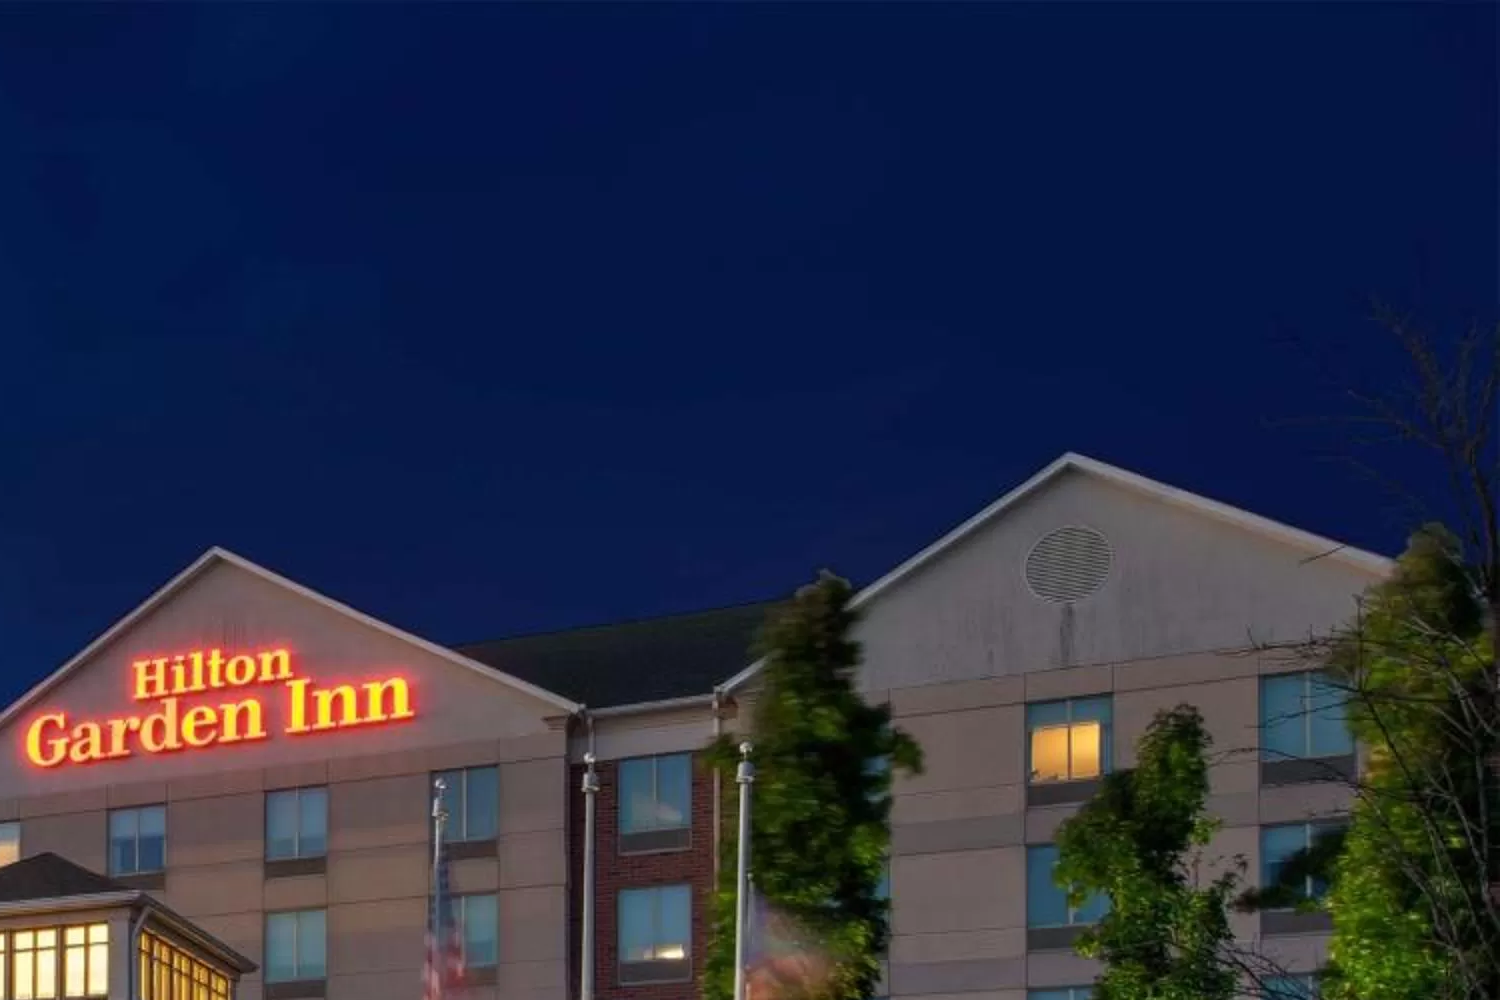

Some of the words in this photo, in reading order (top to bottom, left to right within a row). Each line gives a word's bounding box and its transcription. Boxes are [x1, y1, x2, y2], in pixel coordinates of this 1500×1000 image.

[132, 646, 294, 700] Hilton
[25, 698, 267, 767] Garden
[283, 674, 415, 734] Inn
